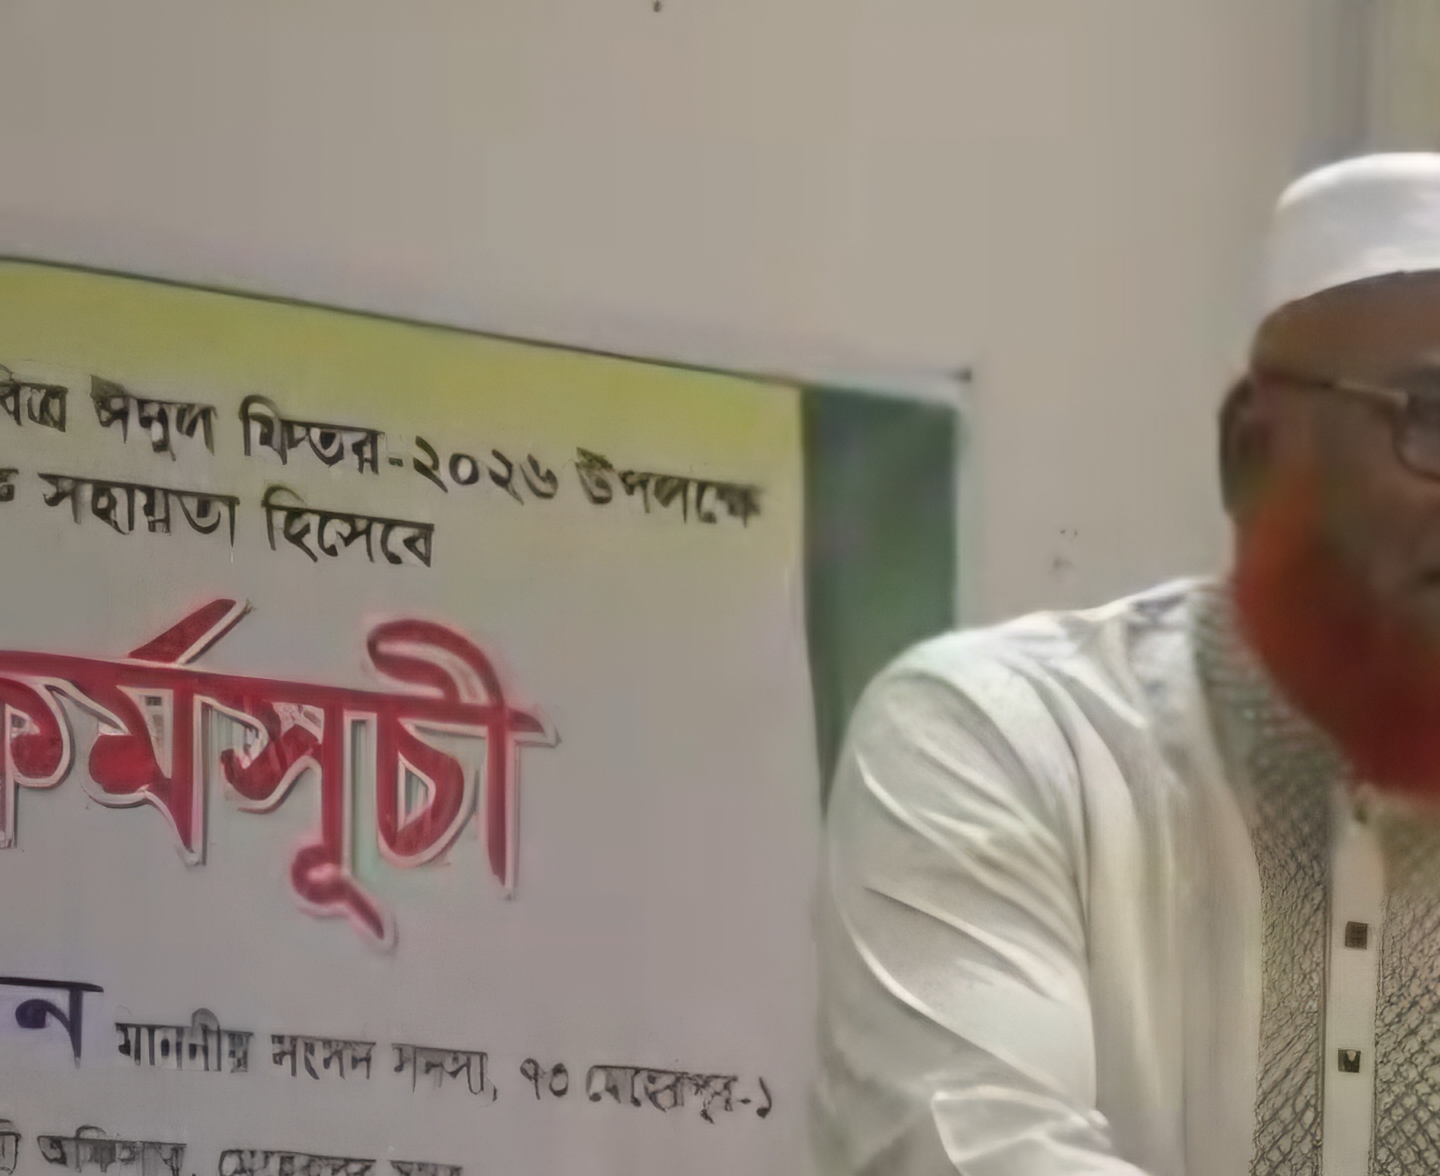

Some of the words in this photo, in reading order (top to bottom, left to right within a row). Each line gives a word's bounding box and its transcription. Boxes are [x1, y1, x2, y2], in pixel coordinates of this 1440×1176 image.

[91, 374, 217, 461] ঈদুল
[38, 472, 240, 550] সহায়তা
[262, 485, 434, 568] হিসেবে
